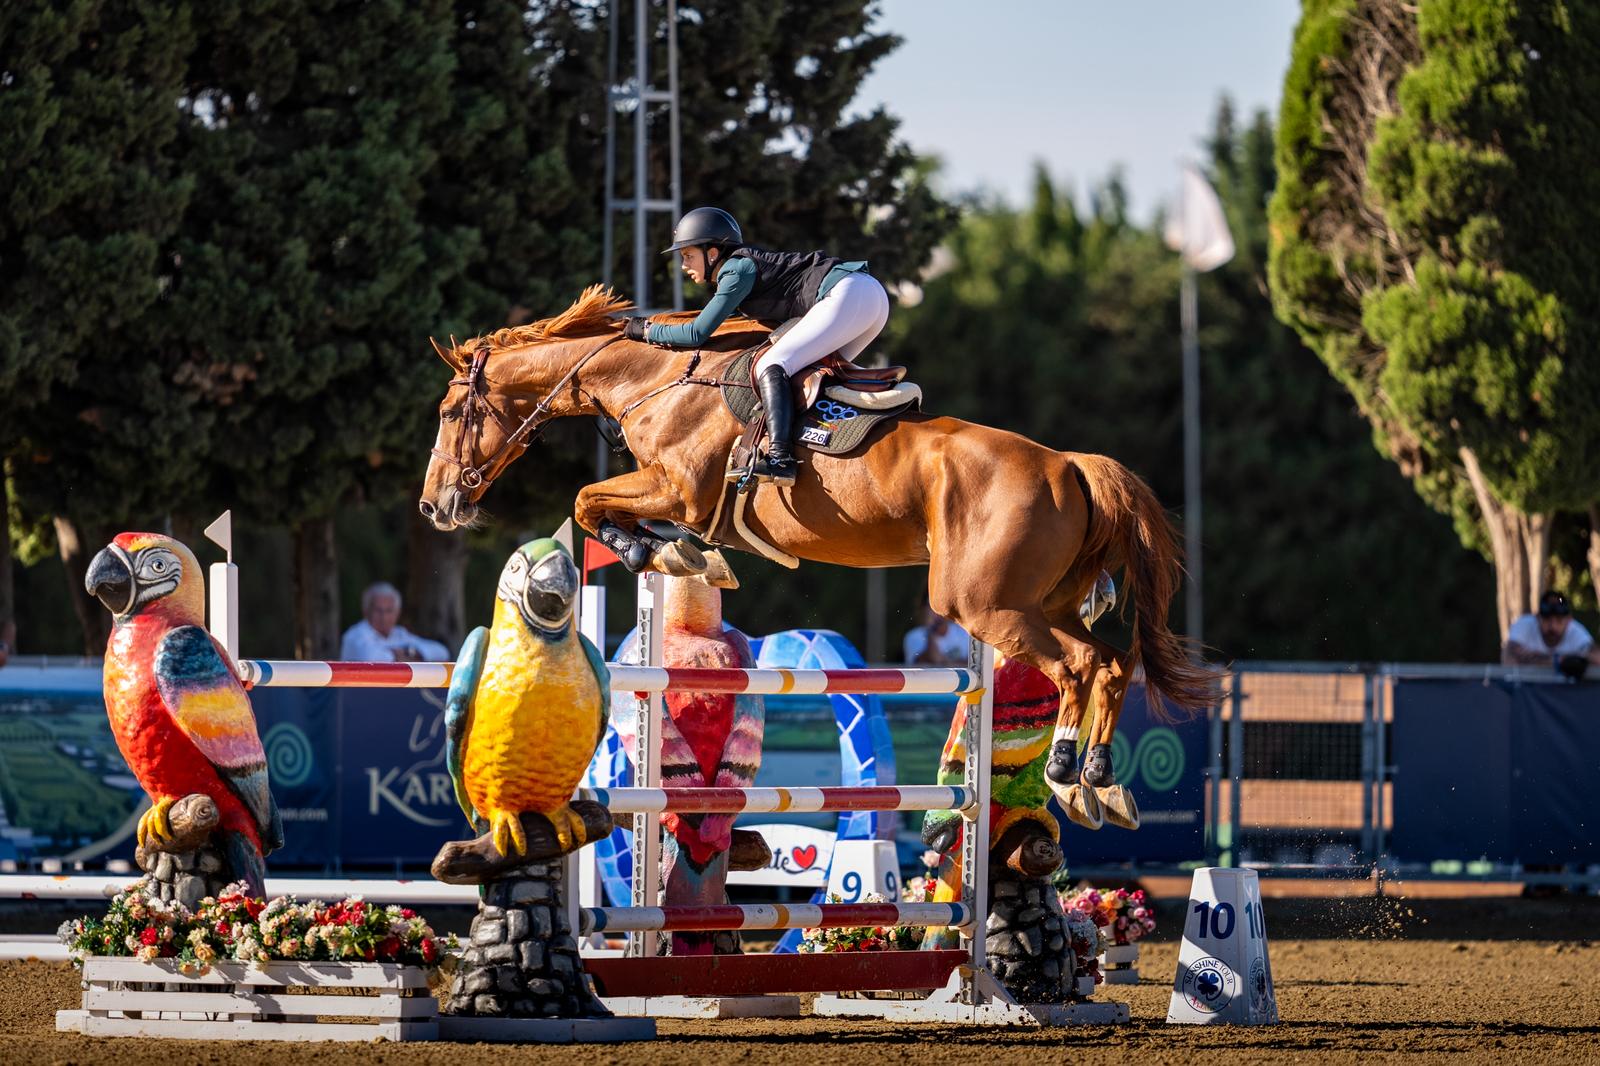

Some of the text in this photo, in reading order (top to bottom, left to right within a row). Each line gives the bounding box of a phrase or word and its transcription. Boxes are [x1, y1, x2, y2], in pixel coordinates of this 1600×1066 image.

[804, 431, 825, 443] 226
[364, 767, 453, 826] KAR
[842, 871, 862, 904] 9
[885, 871, 898, 903] 9
[1194, 901, 1235, 940] 10
[1245, 901, 1264, 939] 10
[1184, 959, 1219, 985] SUNSHINE
[1219, 965, 1233, 985] TOUR
